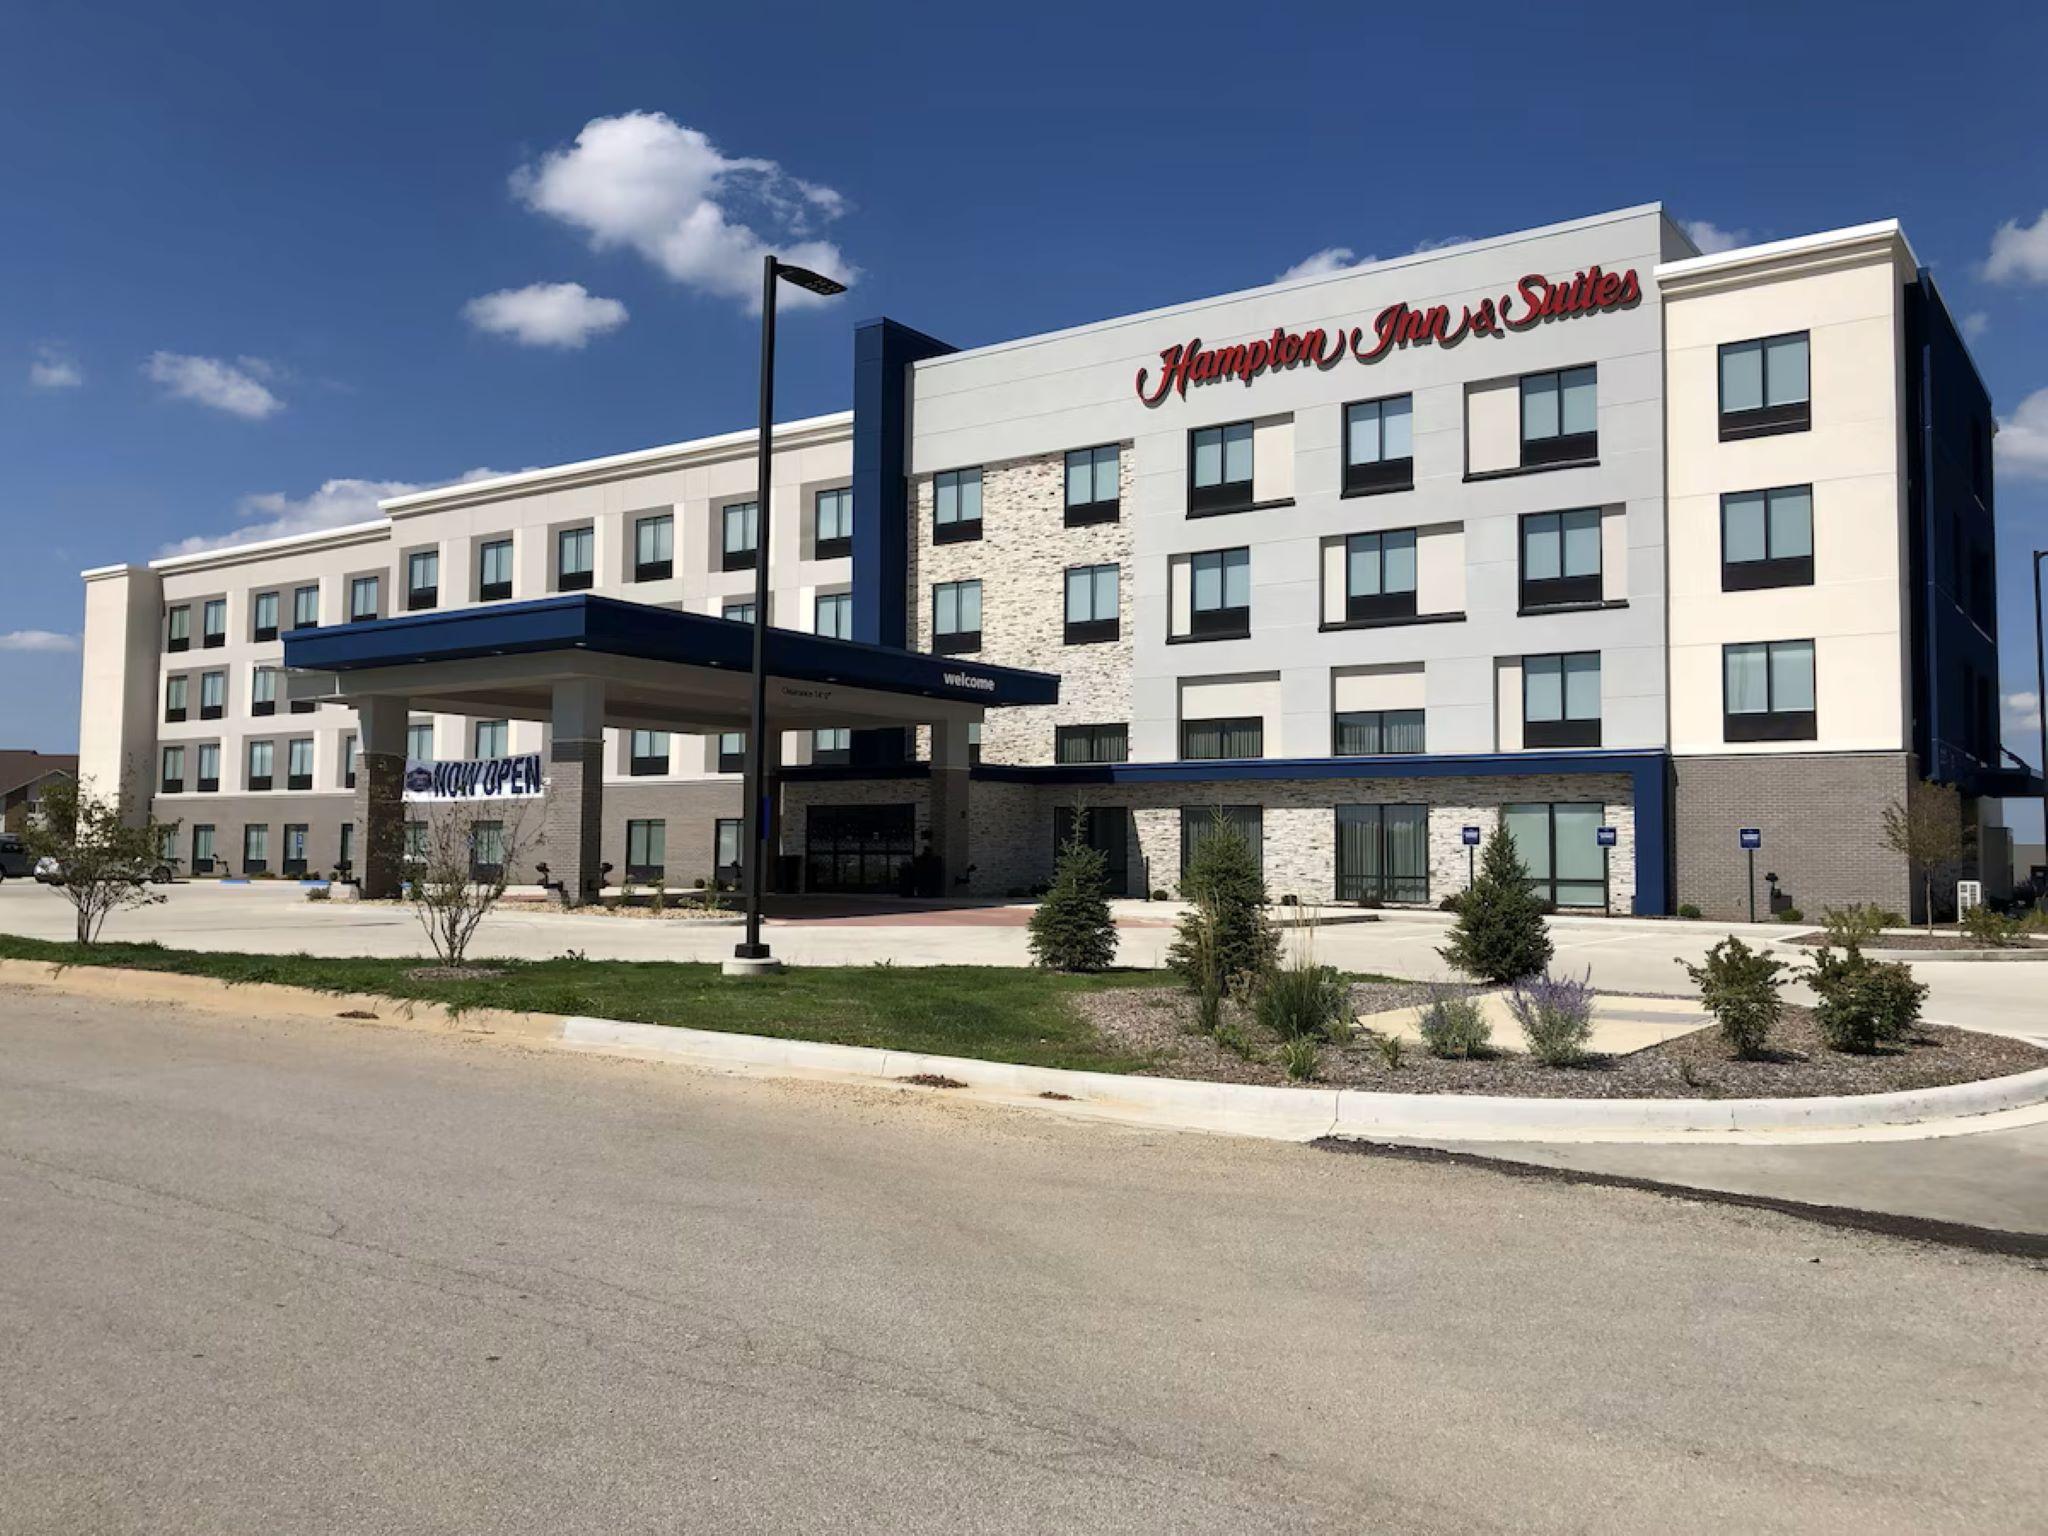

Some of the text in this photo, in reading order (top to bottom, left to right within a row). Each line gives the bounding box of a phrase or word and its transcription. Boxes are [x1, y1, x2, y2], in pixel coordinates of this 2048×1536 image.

[1136, 266, 1642, 407] Hampton Inn & Suites
[944, 672, 995, 692] welcome
[434, 755, 540, 797] NOW OPEN
